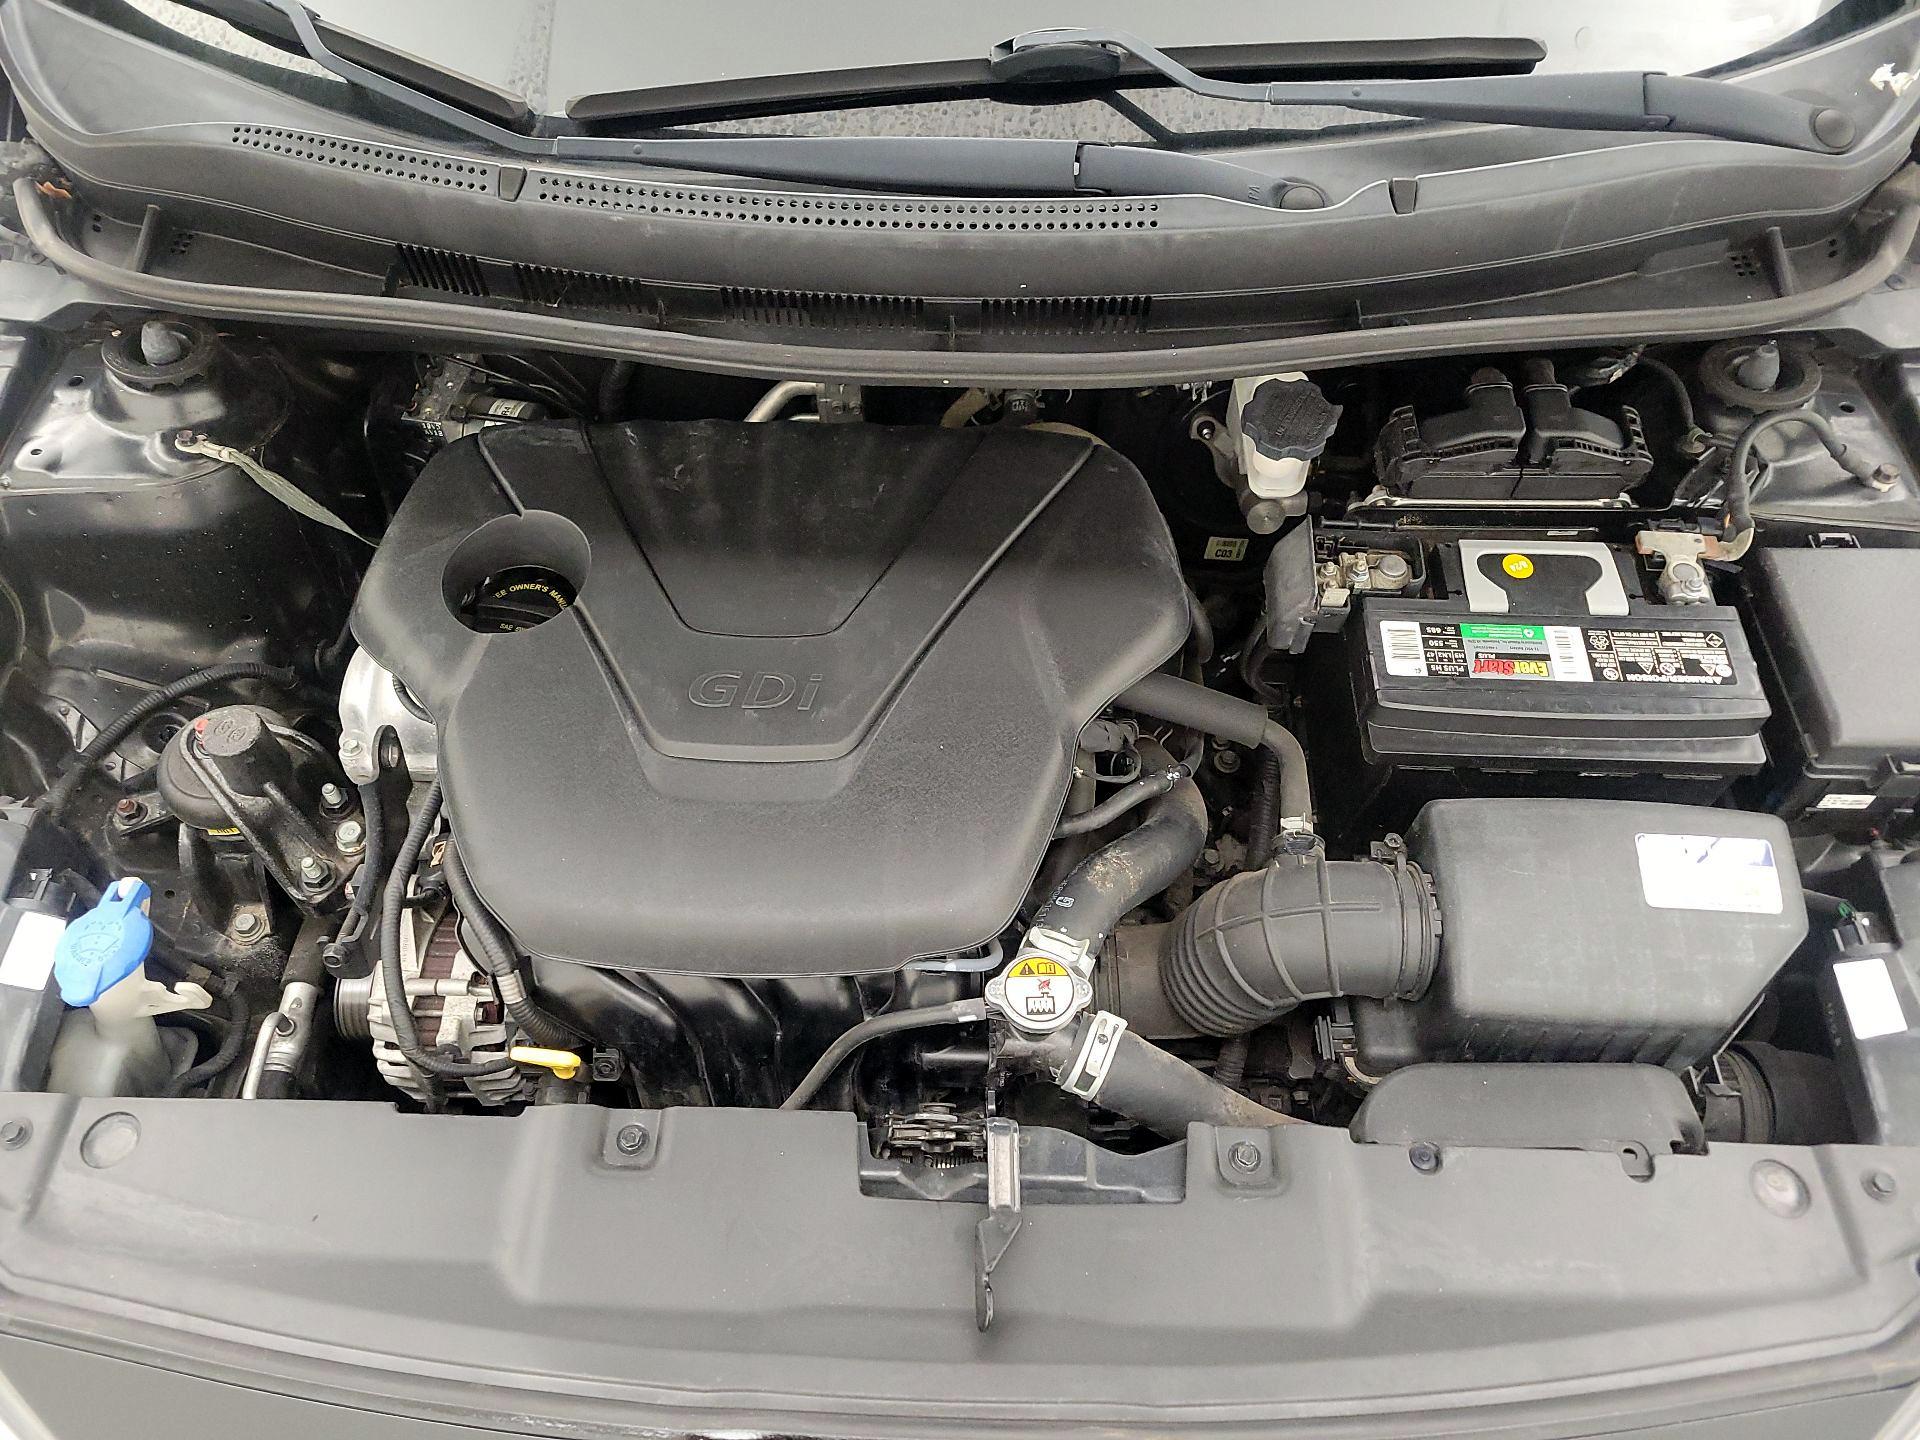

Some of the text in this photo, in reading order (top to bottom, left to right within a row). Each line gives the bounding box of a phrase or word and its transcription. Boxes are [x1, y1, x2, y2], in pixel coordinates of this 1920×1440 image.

[493, 589, 508, 599] EE
[509, 583, 549, 593] OWNER'S
[1477, 652, 1496, 660] PLUS
[1443, 664, 1465, 672] PLUS
[1473, 659, 1549, 677] EverStart
[688, 670, 824, 711] GDi
